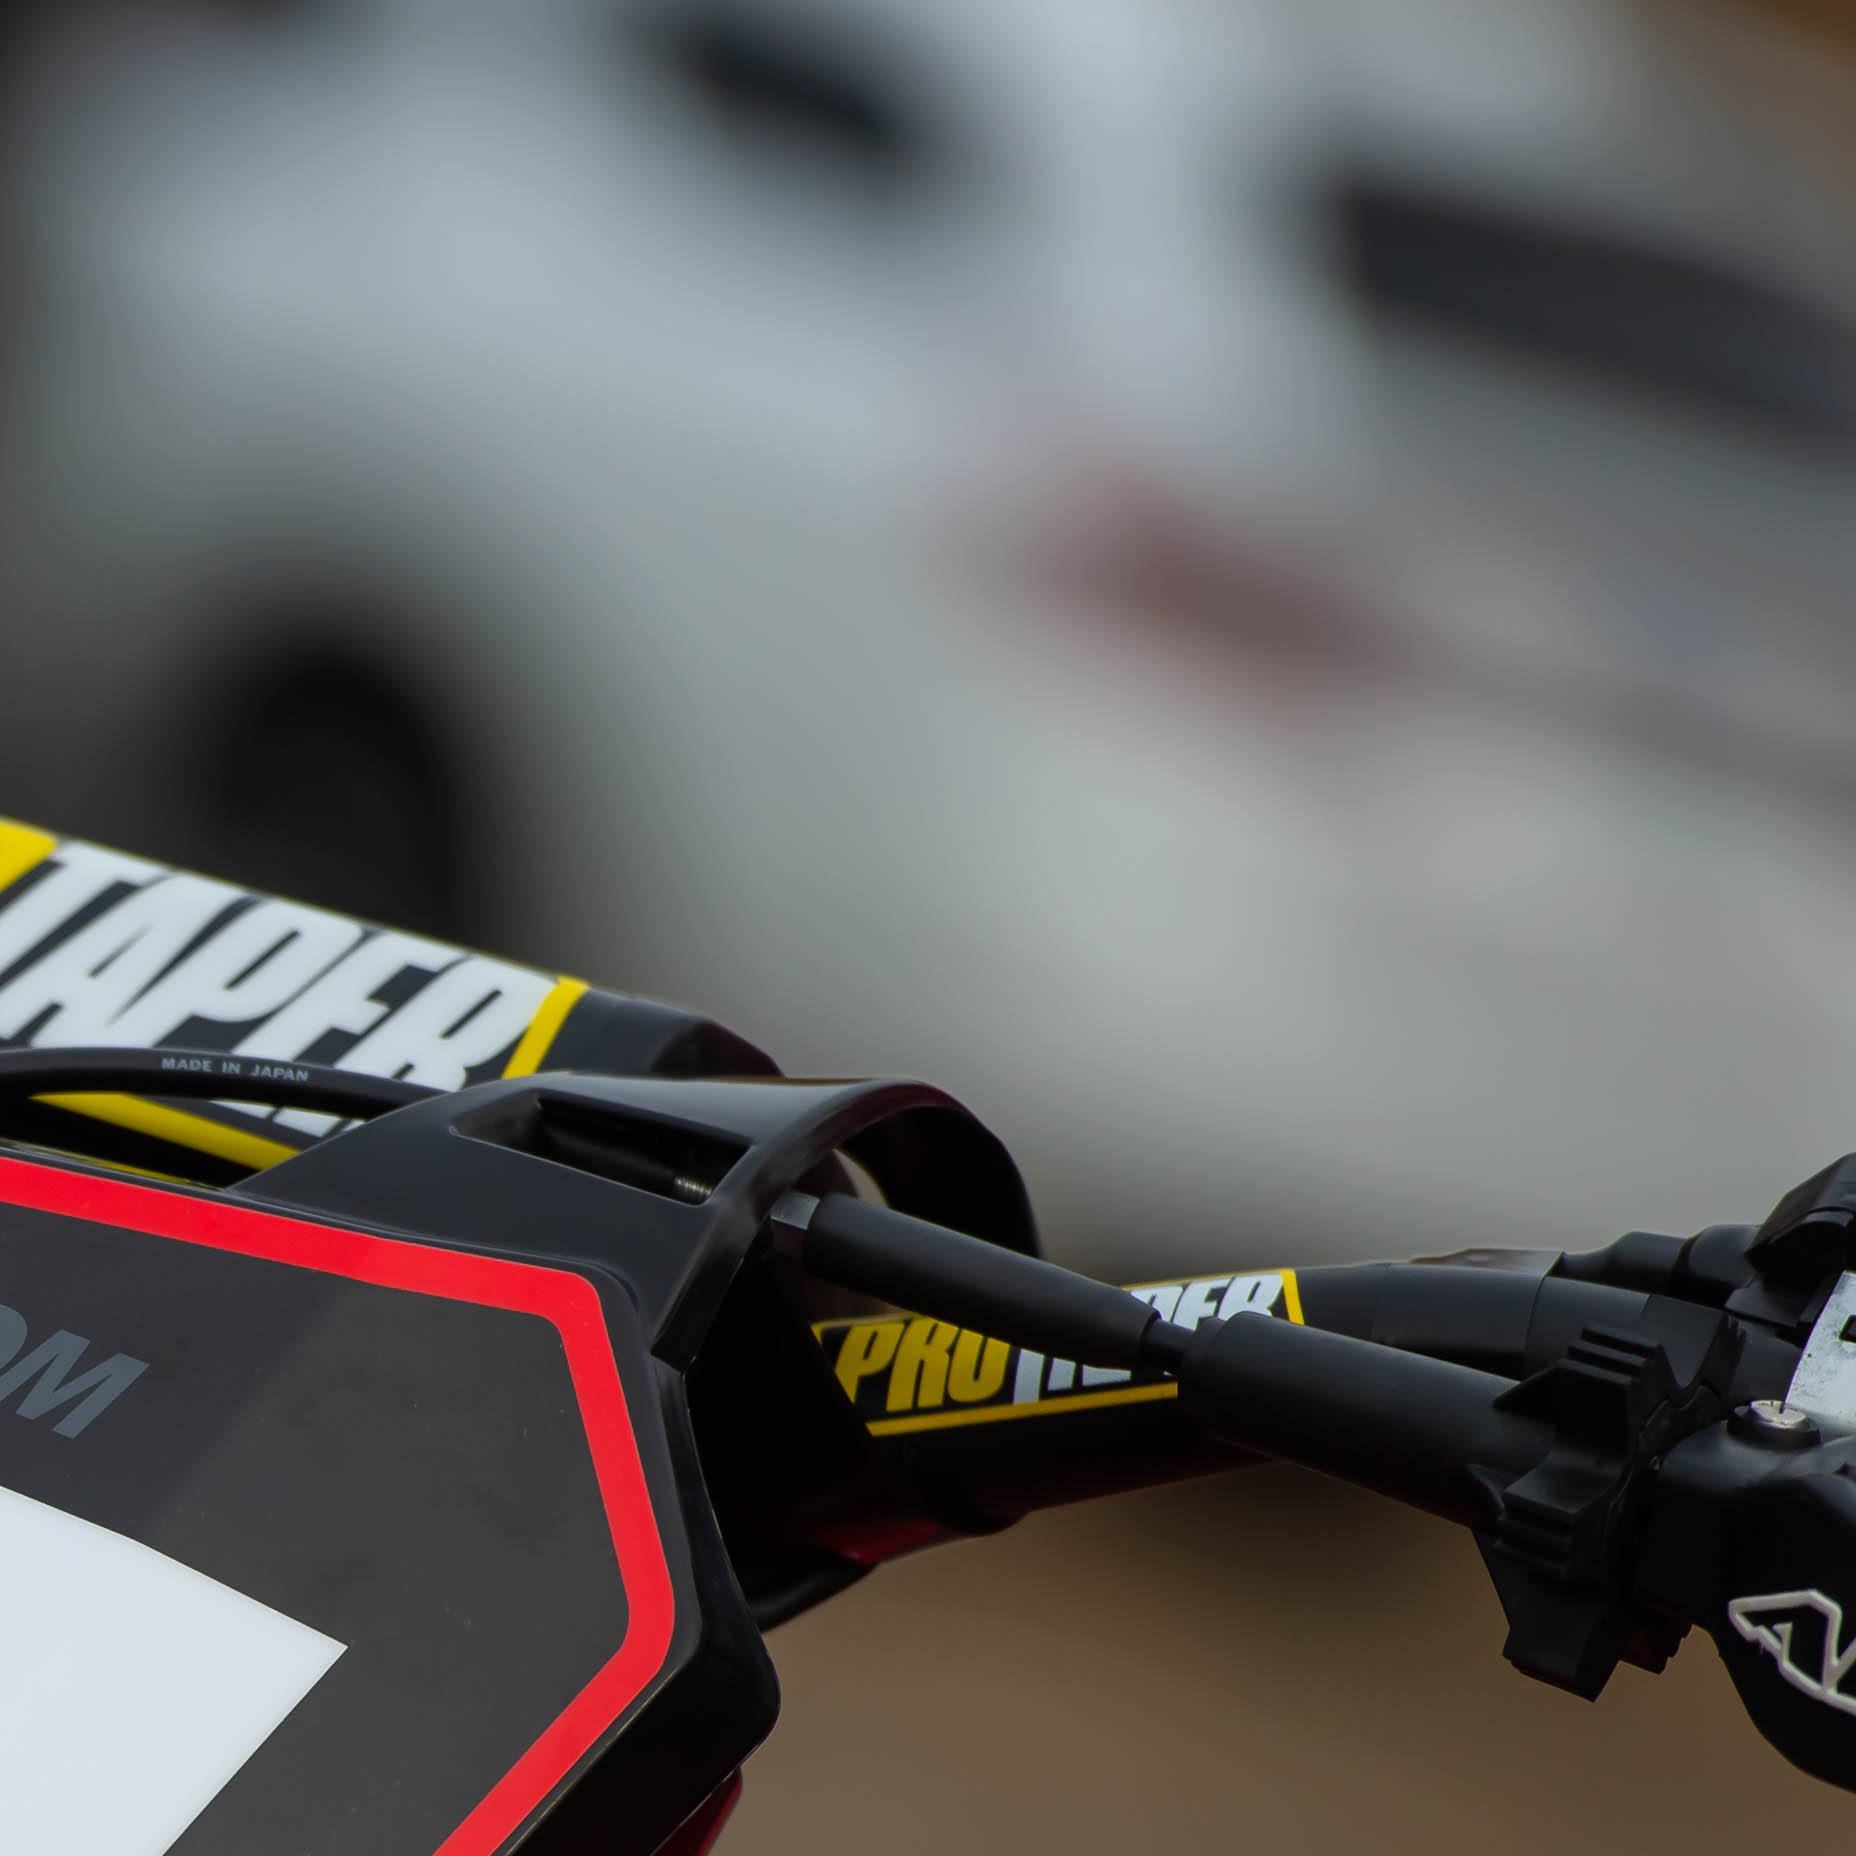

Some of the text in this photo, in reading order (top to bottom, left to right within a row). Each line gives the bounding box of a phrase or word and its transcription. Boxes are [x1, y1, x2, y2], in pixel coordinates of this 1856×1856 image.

[161, 1057, 310, 1083] MADE IN JAPAN
